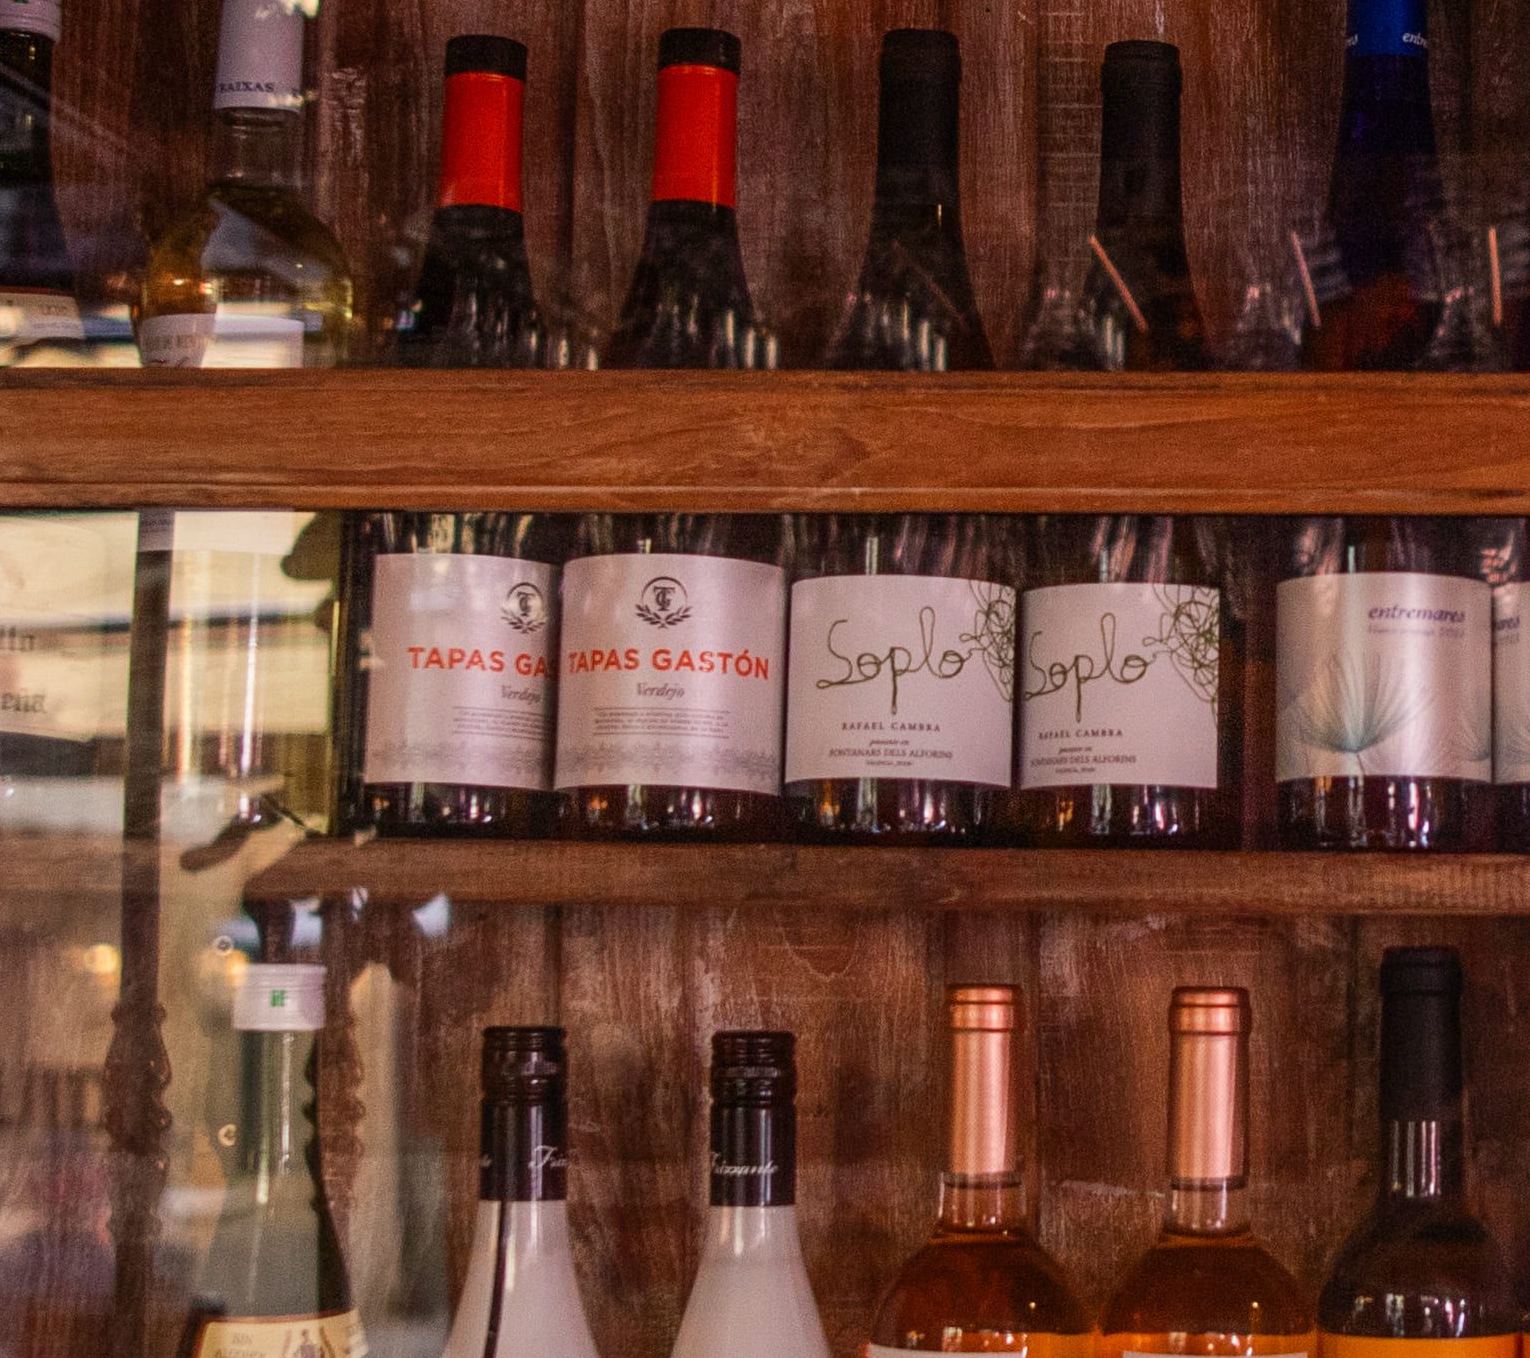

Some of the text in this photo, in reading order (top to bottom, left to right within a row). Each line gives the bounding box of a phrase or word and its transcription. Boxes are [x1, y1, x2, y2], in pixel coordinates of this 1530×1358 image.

[406, 645, 506, 673] TAPAS
[568, 648, 769, 682] TAPAS GASTÓN
[816, 606, 965, 716] Soplo
[1024, 612, 1149, 724] Soplo
